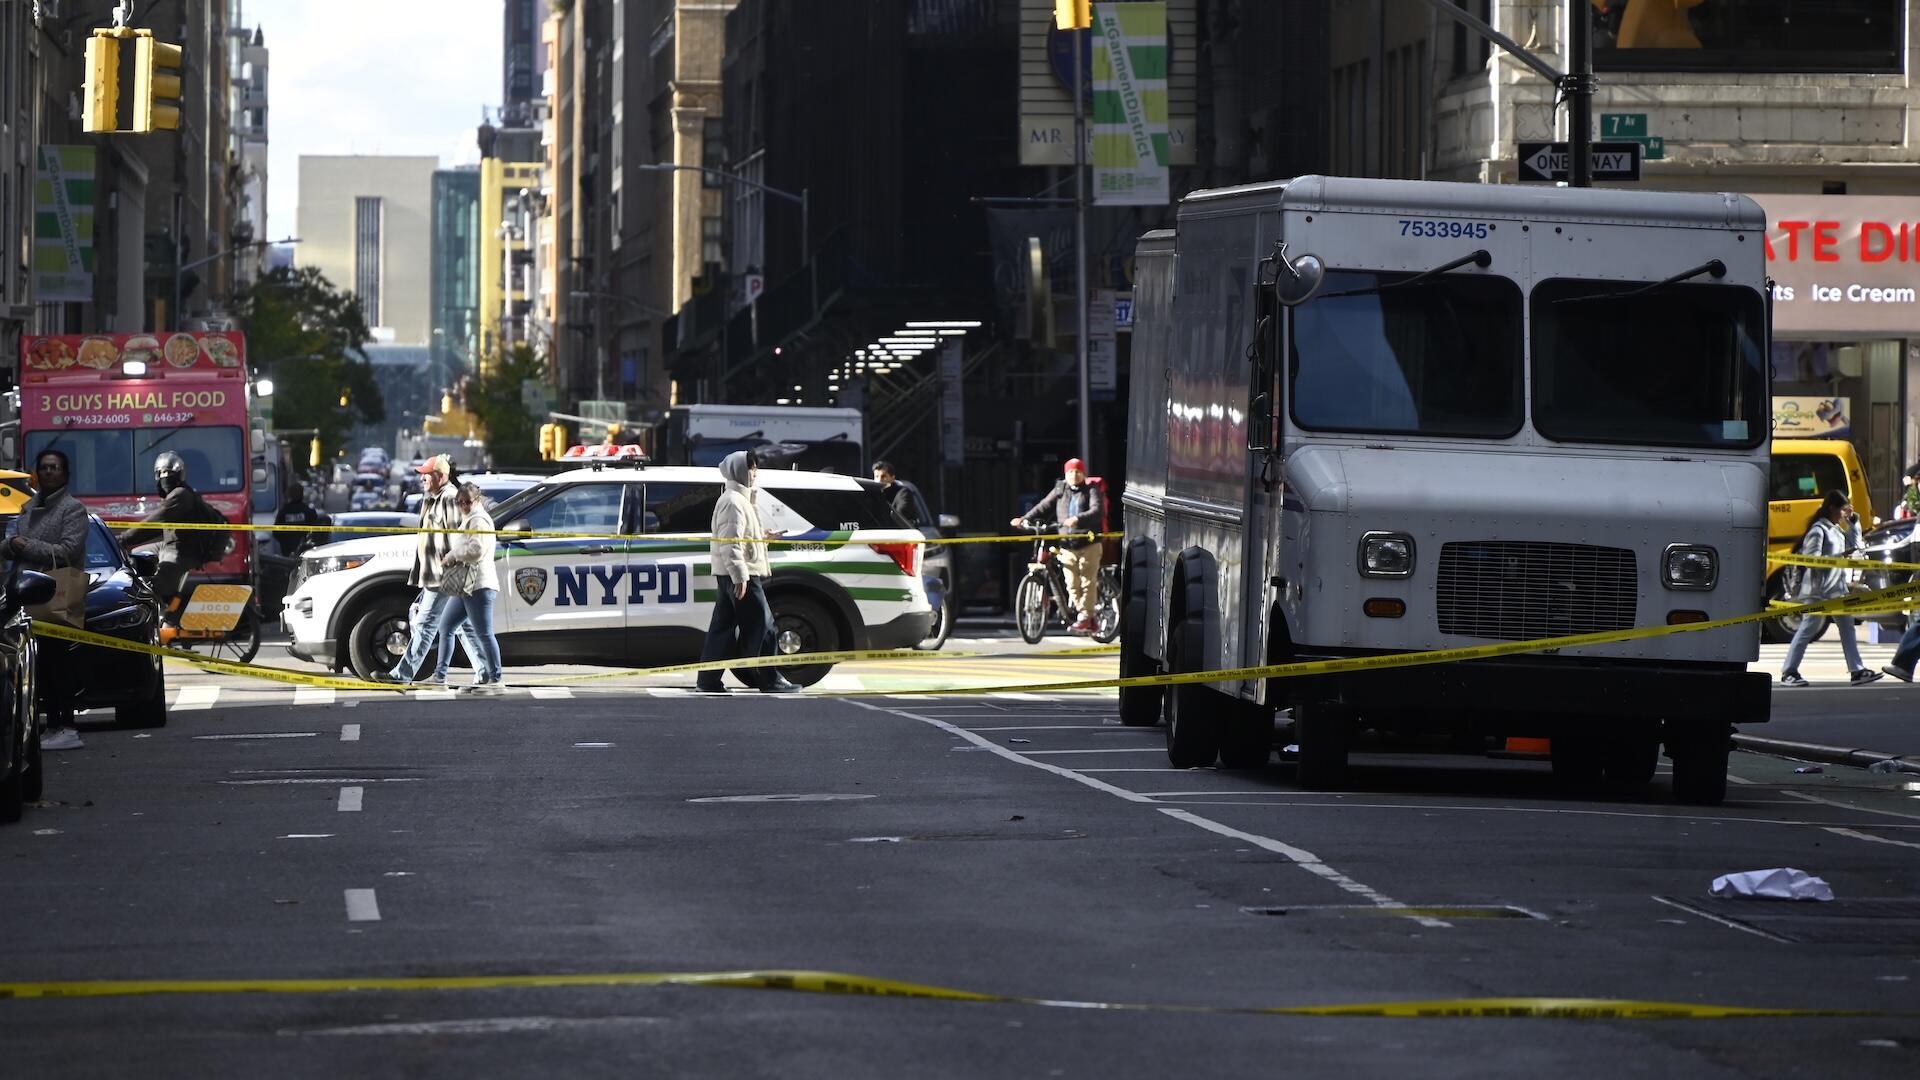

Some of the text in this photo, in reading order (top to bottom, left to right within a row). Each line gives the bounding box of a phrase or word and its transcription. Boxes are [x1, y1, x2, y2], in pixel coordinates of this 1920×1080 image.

[1104, 17, 1151, 159] #GarmentDistrict
[1611, 116, 1635, 134] 7 Av
[1030, 129, 1062, 144] MR
[1649, 139, 1660, 149] Av
[1537, 154, 1568, 170] ONE
[1398, 220, 1488, 239] 7533945
[1812, 284, 1842, 301] Ice
[1847, 284, 1916, 302] Cream
[41, 391, 226, 411] 3 GUYS HALAL FOOD
[64, 414, 130, 425] 99-632-6005
[839, 522, 860, 531] MTS
[378, 549, 415, 560] POLIC
[554, 563, 687, 606] NYPD
[201, 604, 230, 612] JOCO
